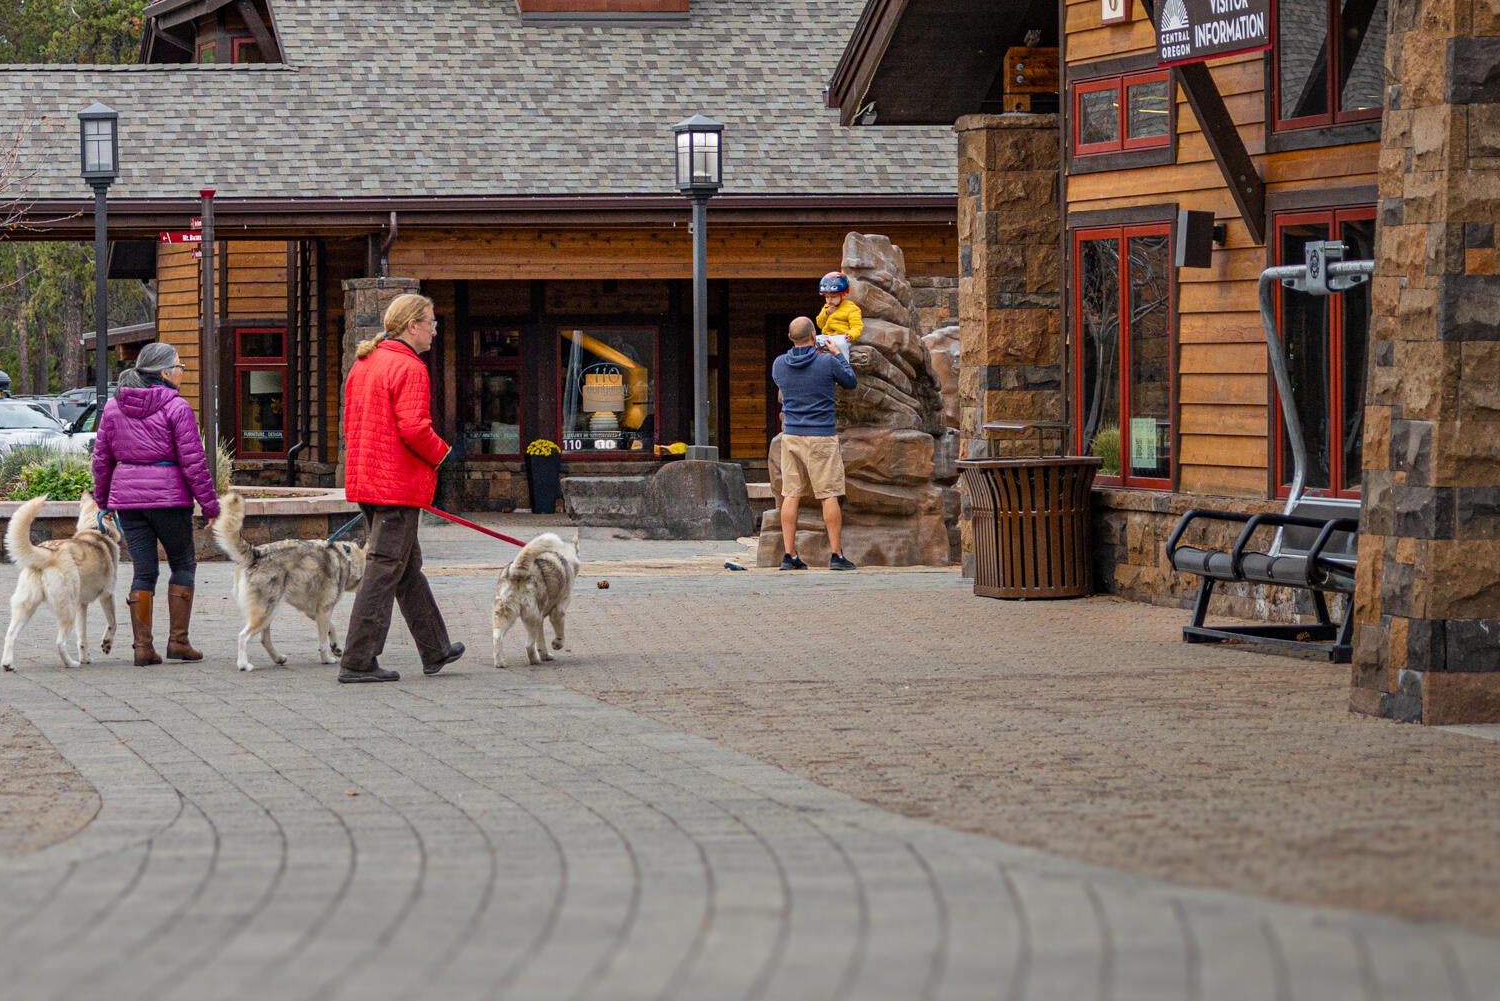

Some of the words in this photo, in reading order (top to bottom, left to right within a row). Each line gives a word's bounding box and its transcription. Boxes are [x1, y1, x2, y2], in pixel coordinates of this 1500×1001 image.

[1195, 12, 1264, 48] INFORMATION
[1161, 31, 1190, 45] CENTRAL
[1162, 43, 1191, 59] OREGON
[563, 440, 581, 450] 110
